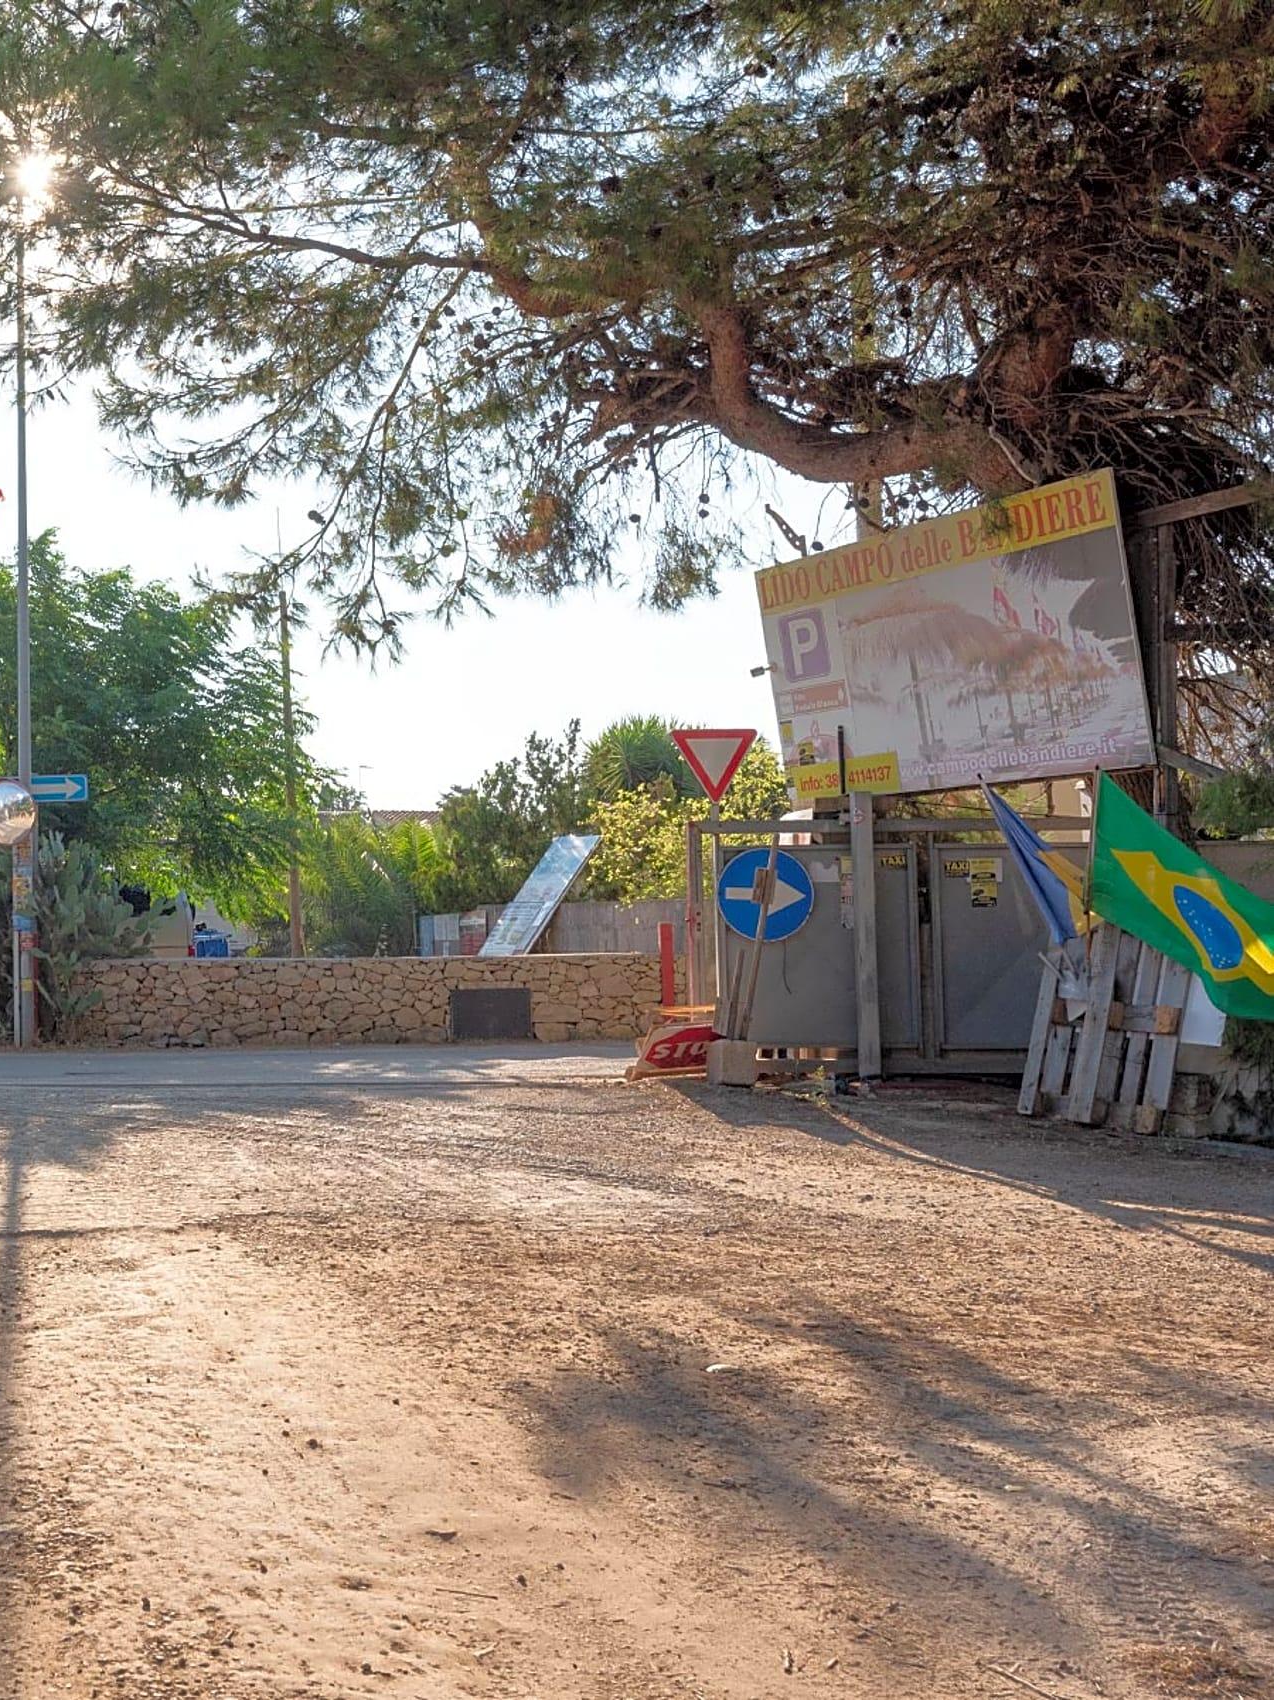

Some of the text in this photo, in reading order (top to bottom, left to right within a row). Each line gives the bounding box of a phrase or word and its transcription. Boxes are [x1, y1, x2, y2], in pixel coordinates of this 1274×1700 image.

[760, 566, 811, 610] LIDO
[816, 542, 895, 596] CAMPO
[900, 529, 953, 574] delle
[788, 618, 819, 676] P
[881, 855, 907, 867] TAXI
[944, 861, 970, 873] TAXI
[652, 1041, 708, 1060] STO
